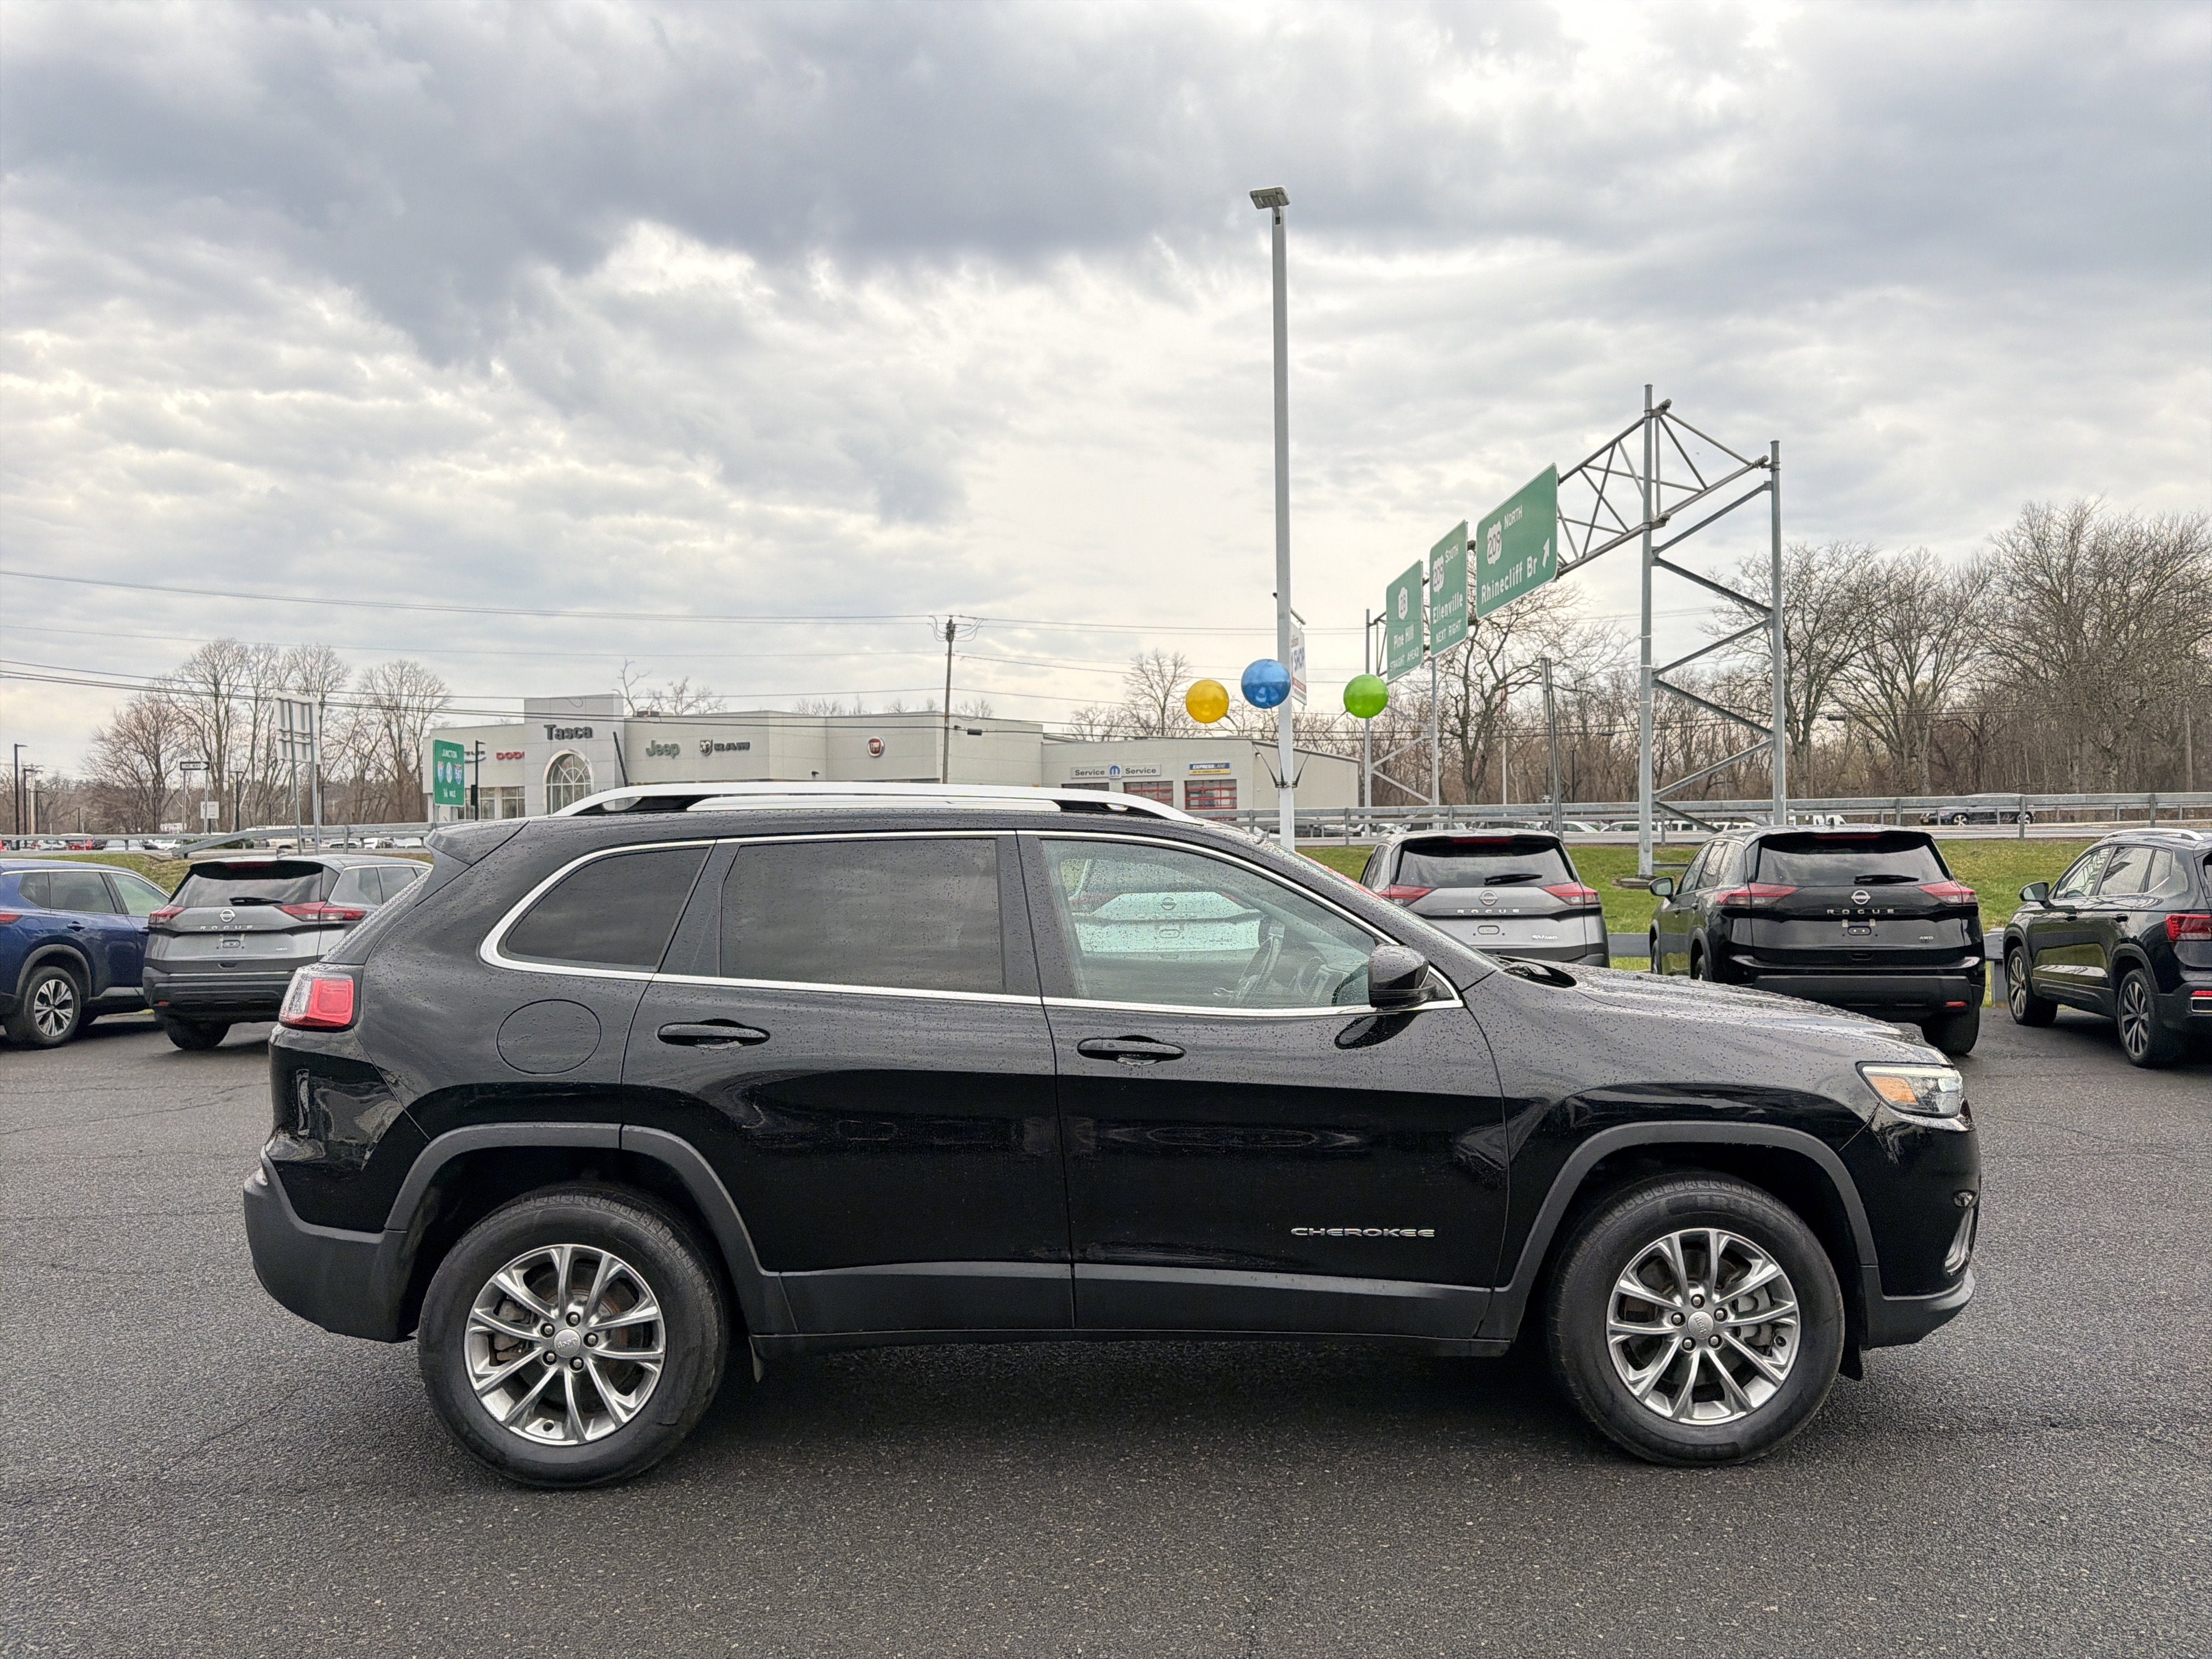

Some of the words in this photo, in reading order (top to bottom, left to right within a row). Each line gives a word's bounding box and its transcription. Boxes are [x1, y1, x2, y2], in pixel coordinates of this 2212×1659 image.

[1504, 505, 1522, 530] NORTH
[1488, 531, 1501, 558] 209
[1434, 564, 1443, 587] 209
[1481, 561, 1523, 604] Rhinecliff
[1527, 555, 1537, 578] Br
[1432, 591, 1463, 624] Ellenville
[1393, 634, 1404, 650] Pine
[1436, 628, 1447, 644] NEXT
[1448, 619, 1462, 637] RIGHT
[544, 724, 593, 741] Tasca
[646, 740, 680, 758] Jeep
[714, 742, 751, 752] RAM
[1291, 1227, 1435, 1237] CHEROKEE
